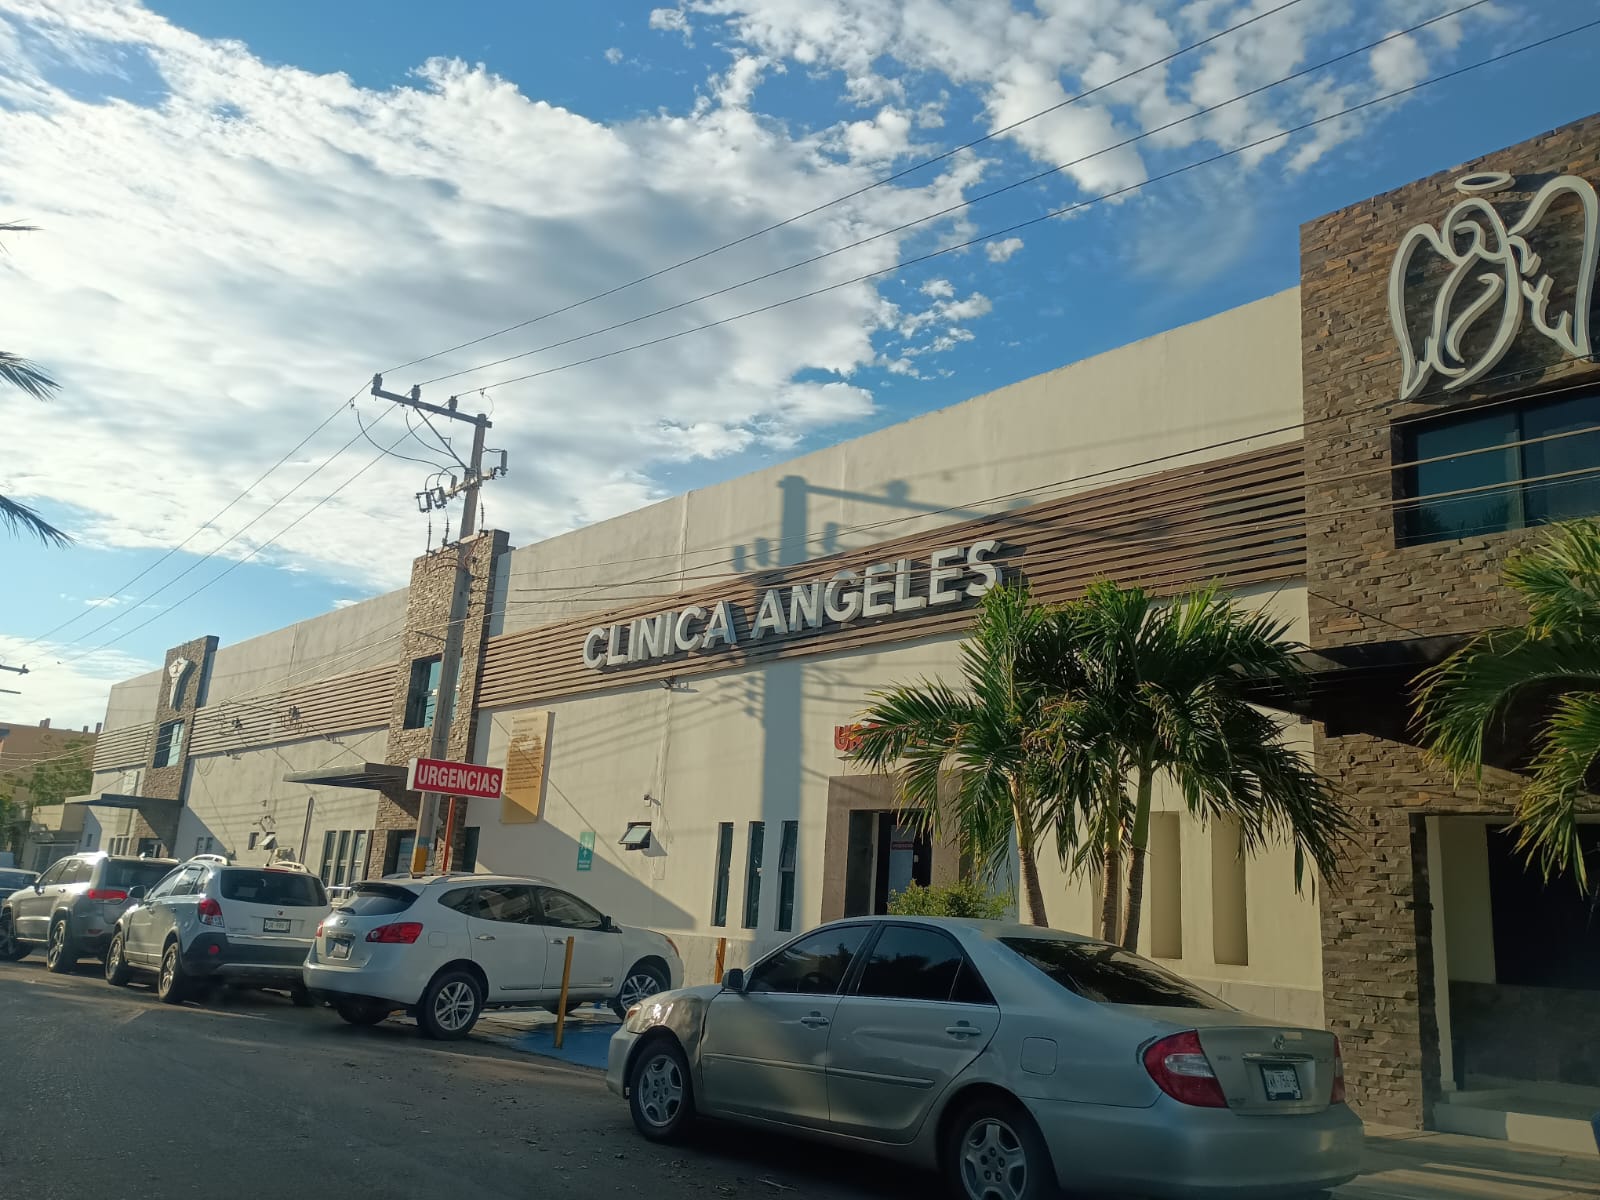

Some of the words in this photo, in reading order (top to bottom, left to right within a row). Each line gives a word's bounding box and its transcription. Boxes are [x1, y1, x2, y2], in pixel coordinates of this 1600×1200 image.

[583, 600, 737, 669] CLINICA
[750, 539, 1003, 639] ANGELES
[418, 764, 500, 794] URGENCIAS
